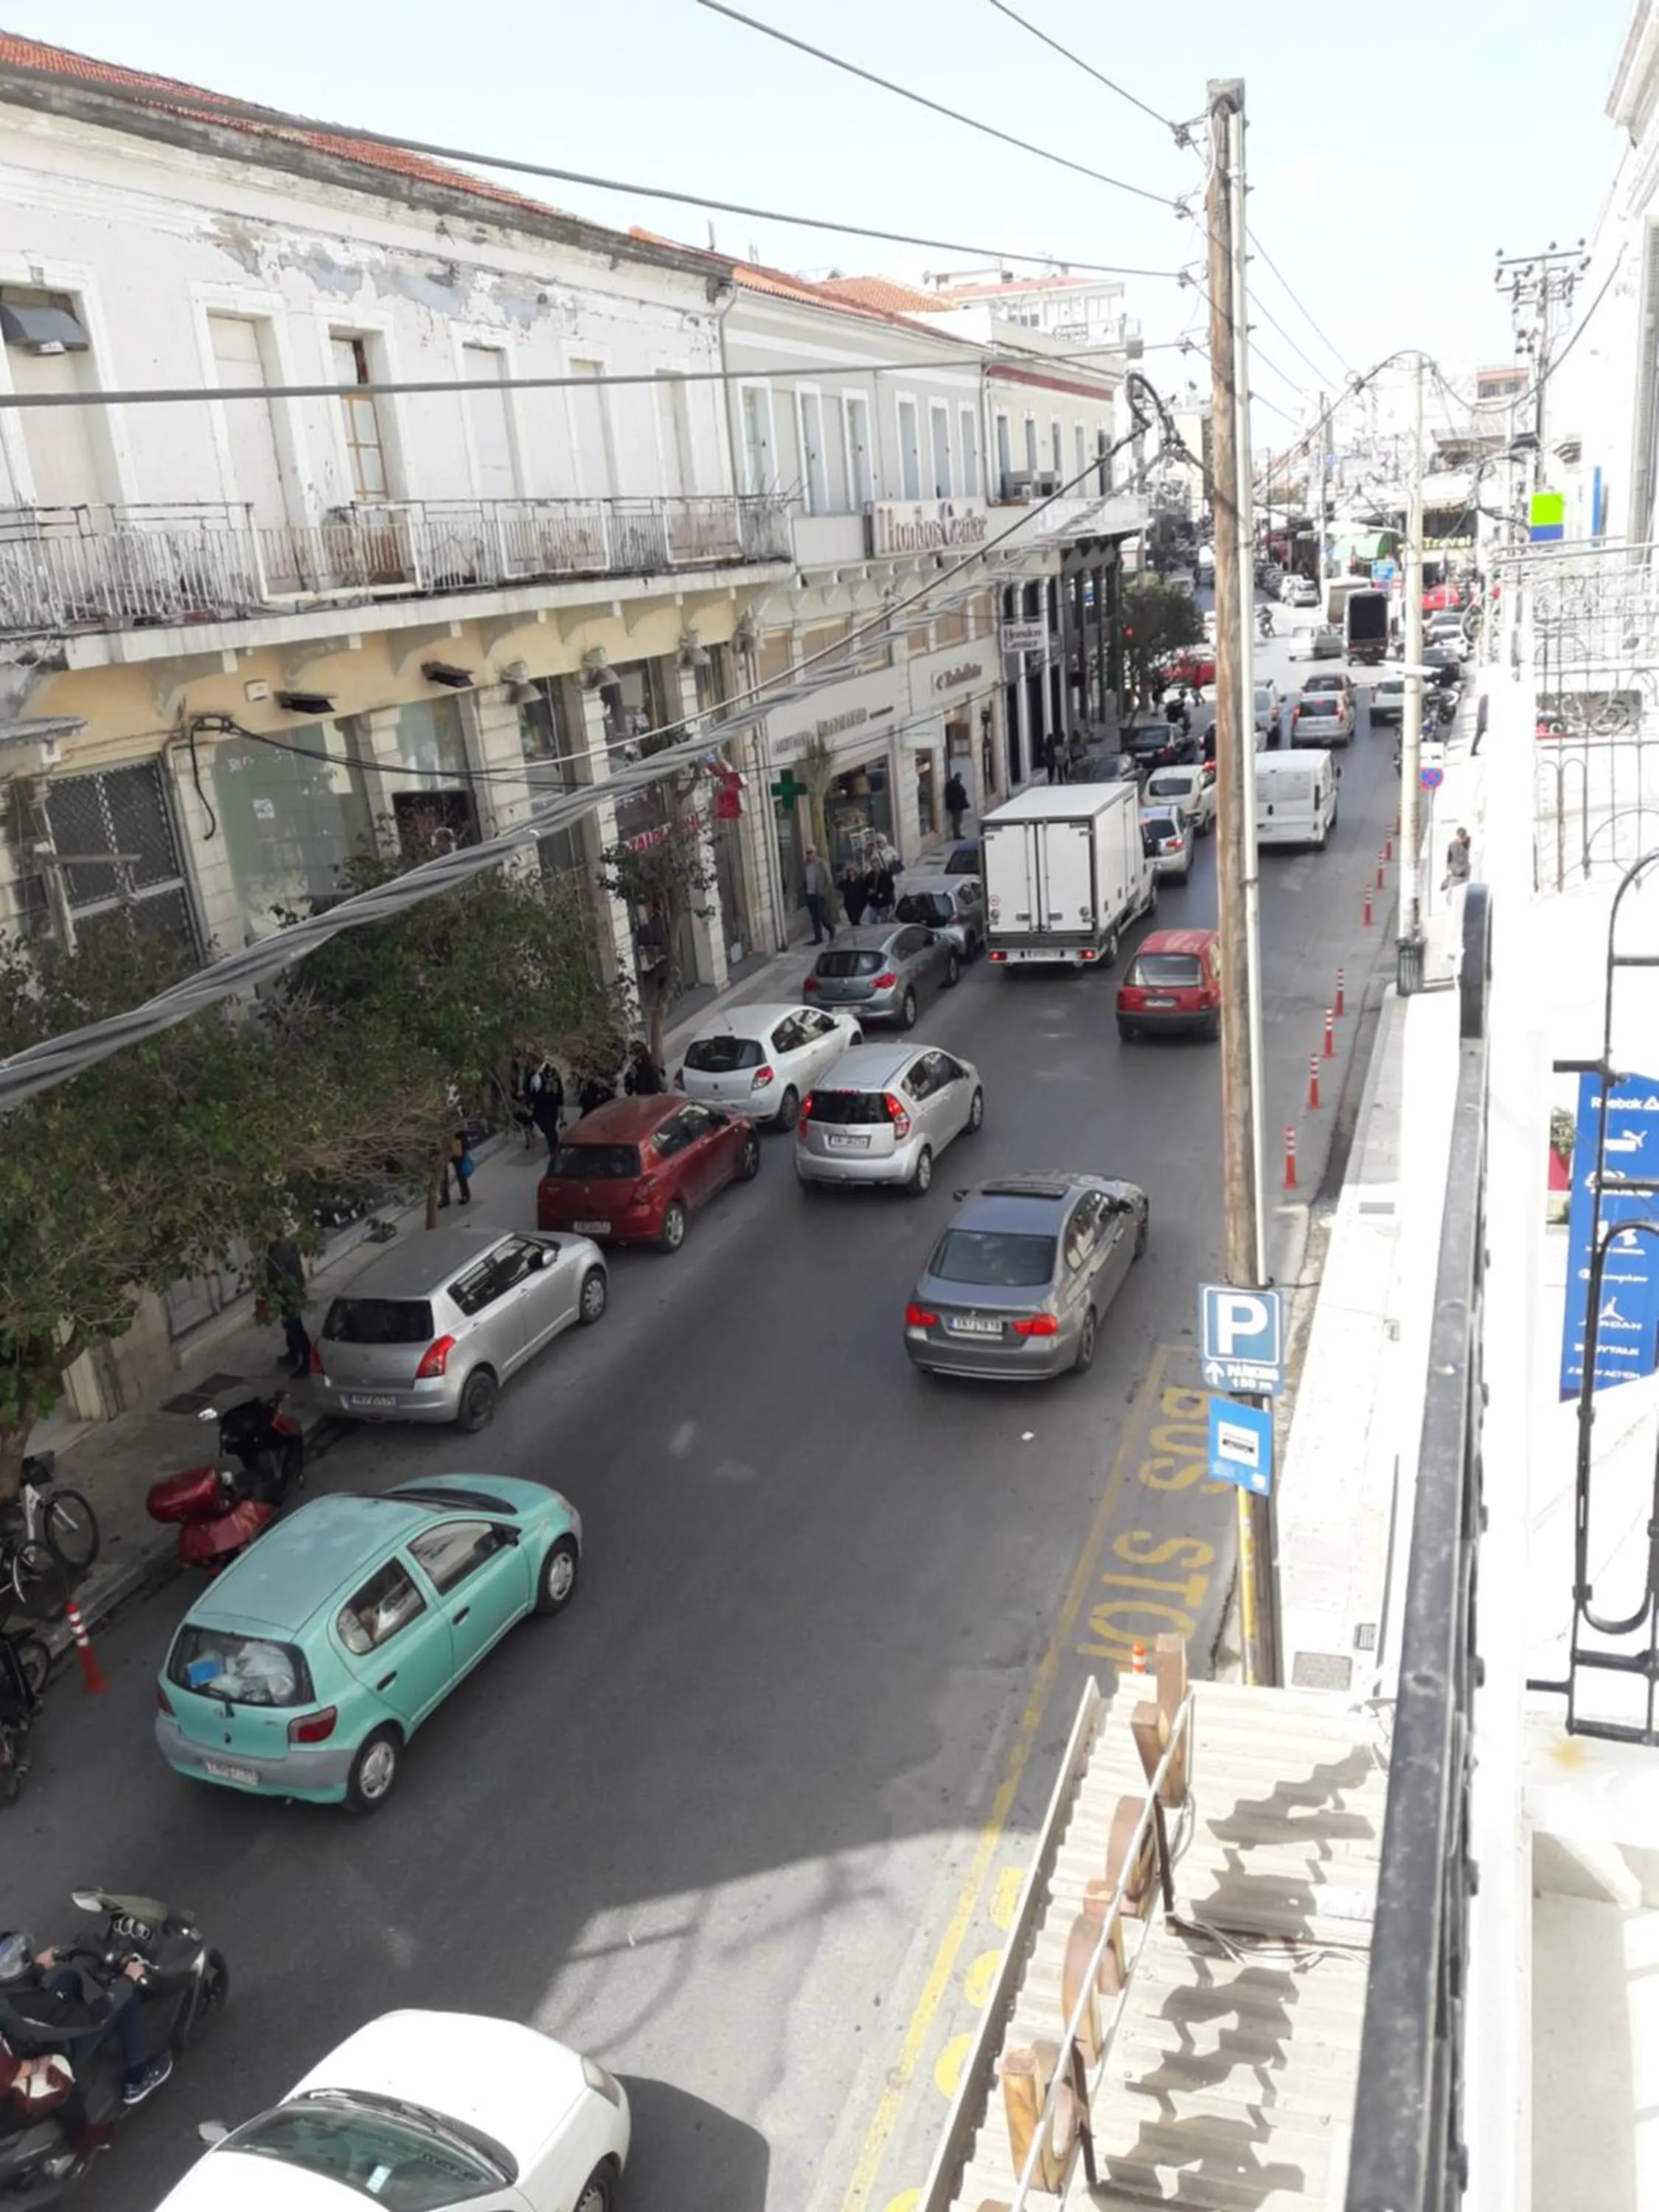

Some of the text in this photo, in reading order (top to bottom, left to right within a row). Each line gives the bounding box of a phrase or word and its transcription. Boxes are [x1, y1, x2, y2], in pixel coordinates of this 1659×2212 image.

[1424, 535, 1472, 550] Travel
[1217, 1294, 1268, 1355] P
[1227, 1363, 1279, 1381] PARKING
[1138, 1386, 1228, 1495] BUS
